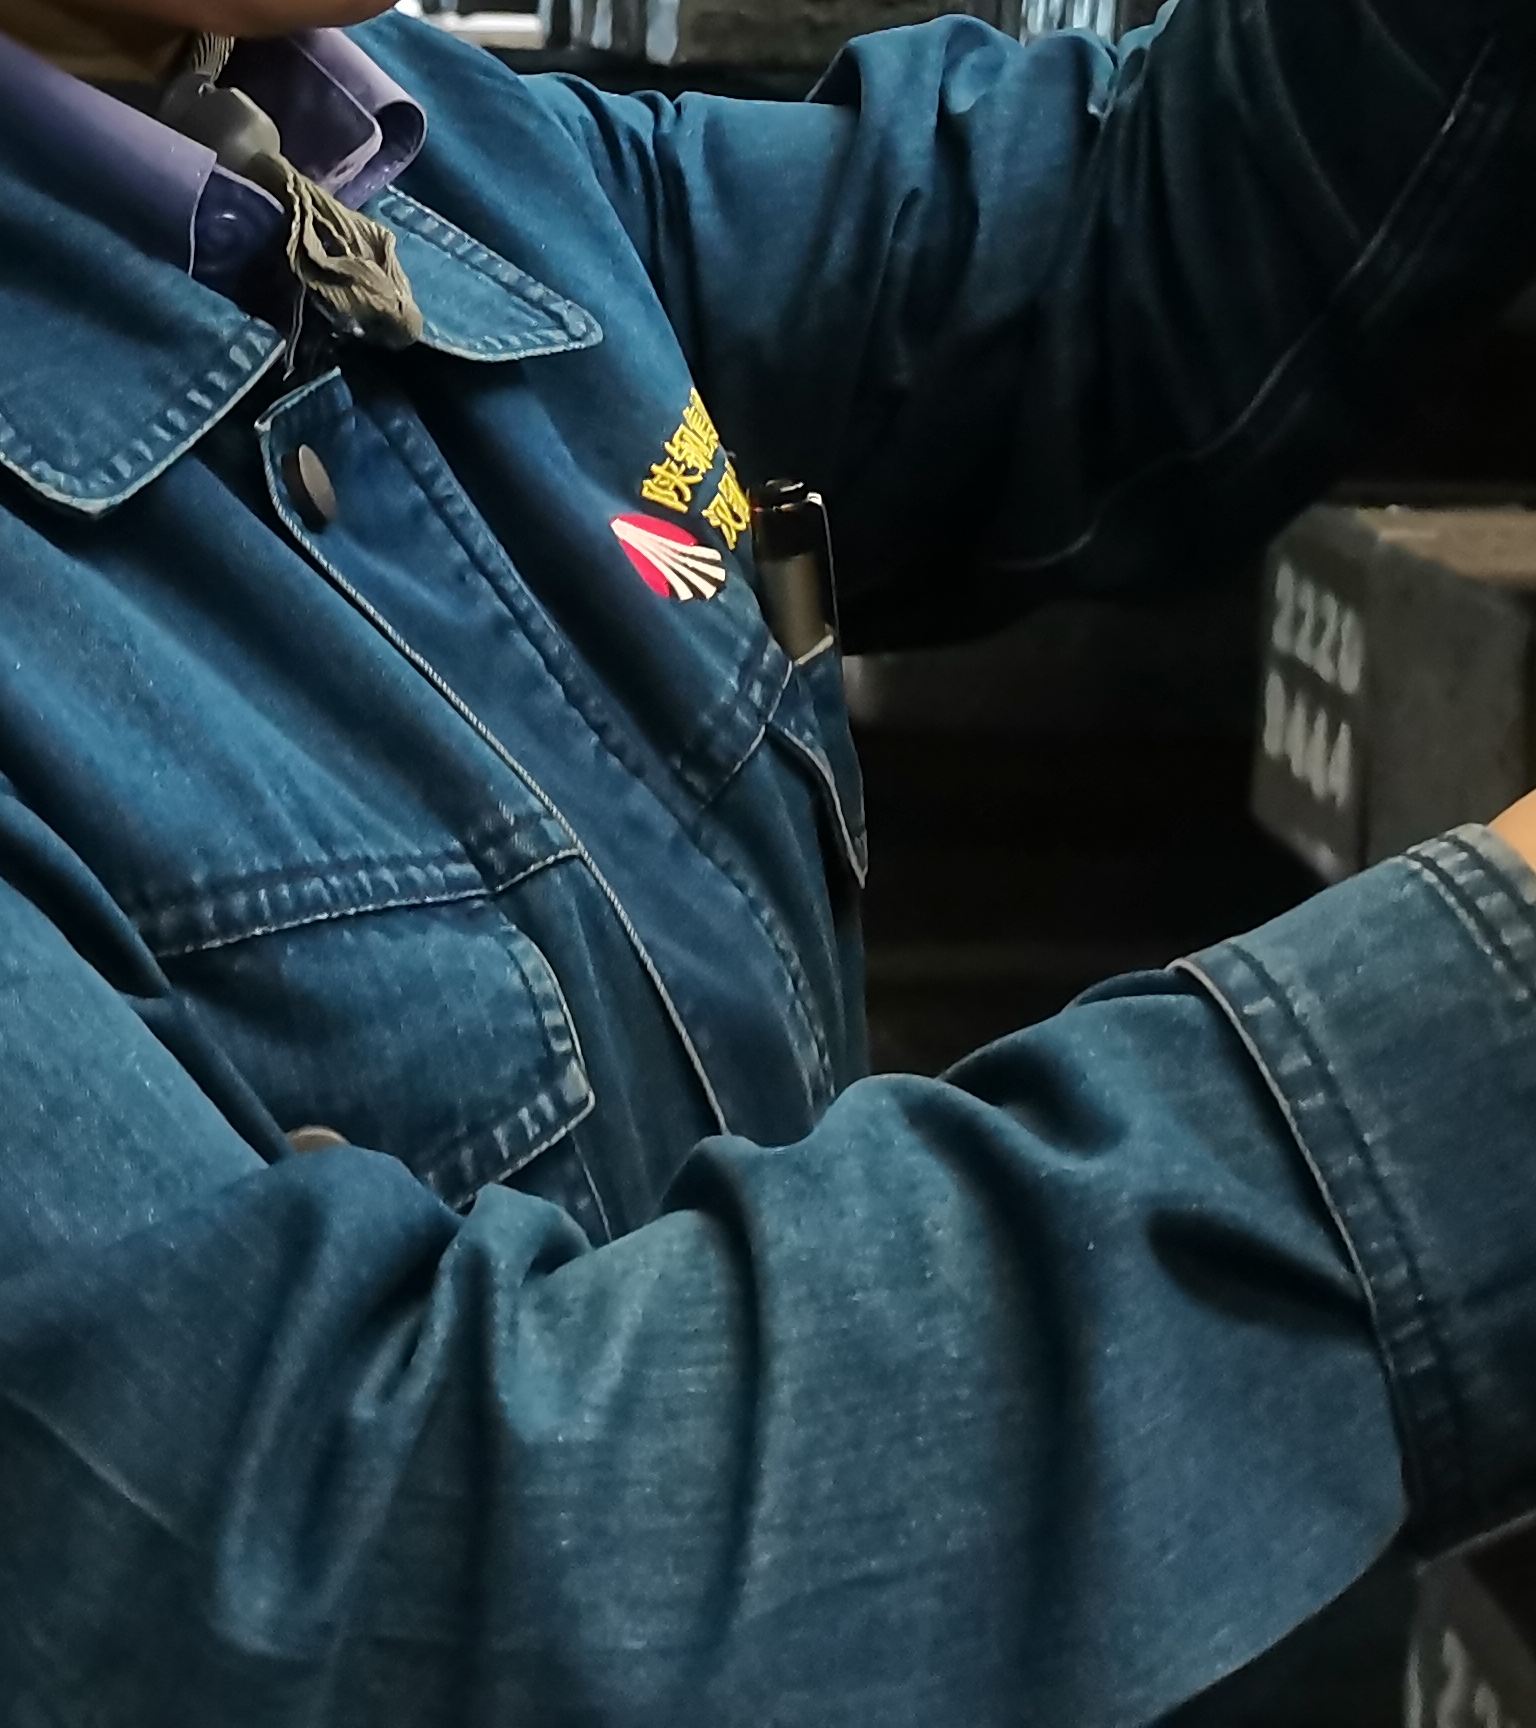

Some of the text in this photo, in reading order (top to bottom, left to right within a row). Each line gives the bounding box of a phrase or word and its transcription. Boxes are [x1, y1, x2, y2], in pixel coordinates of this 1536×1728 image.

[641, 386, 720, 513] 陕钢集
[701, 460, 751, 550] 汉钢
